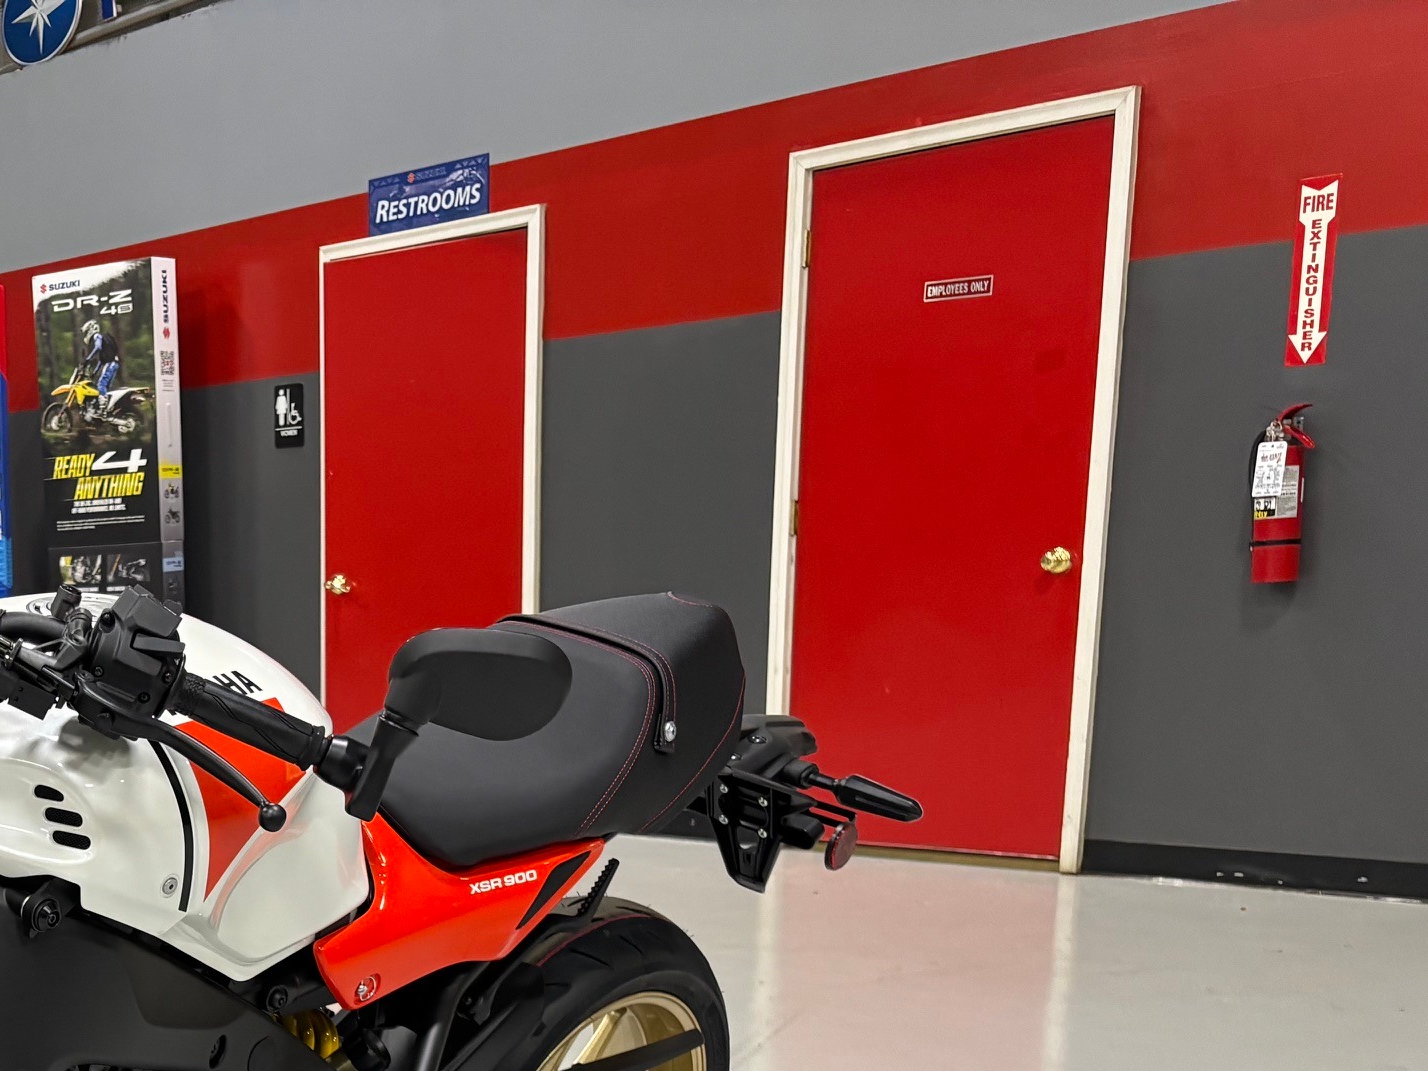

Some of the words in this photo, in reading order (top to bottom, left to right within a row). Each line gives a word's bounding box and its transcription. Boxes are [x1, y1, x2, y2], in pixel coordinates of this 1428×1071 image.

[376, 183, 482, 223] RESTROOMS
[1303, 193, 1335, 213] FIRE
[49, 280, 81, 291] SUZUKI
[162, 269, 170, 323] SUZUKI
[927, 282, 969, 297] EMPLOYEES
[970, 280, 989, 293] ONLY
[1300, 219, 1323, 352] EXTINGUISHER
[51, 289, 133, 312] DR-Z
[53, 453, 95, 479] READY
[91, 449, 147, 472] 4
[74, 472, 145, 500] ANYTHING
[469, 877, 502, 894] XSR
[504, 869, 537, 886] 900
